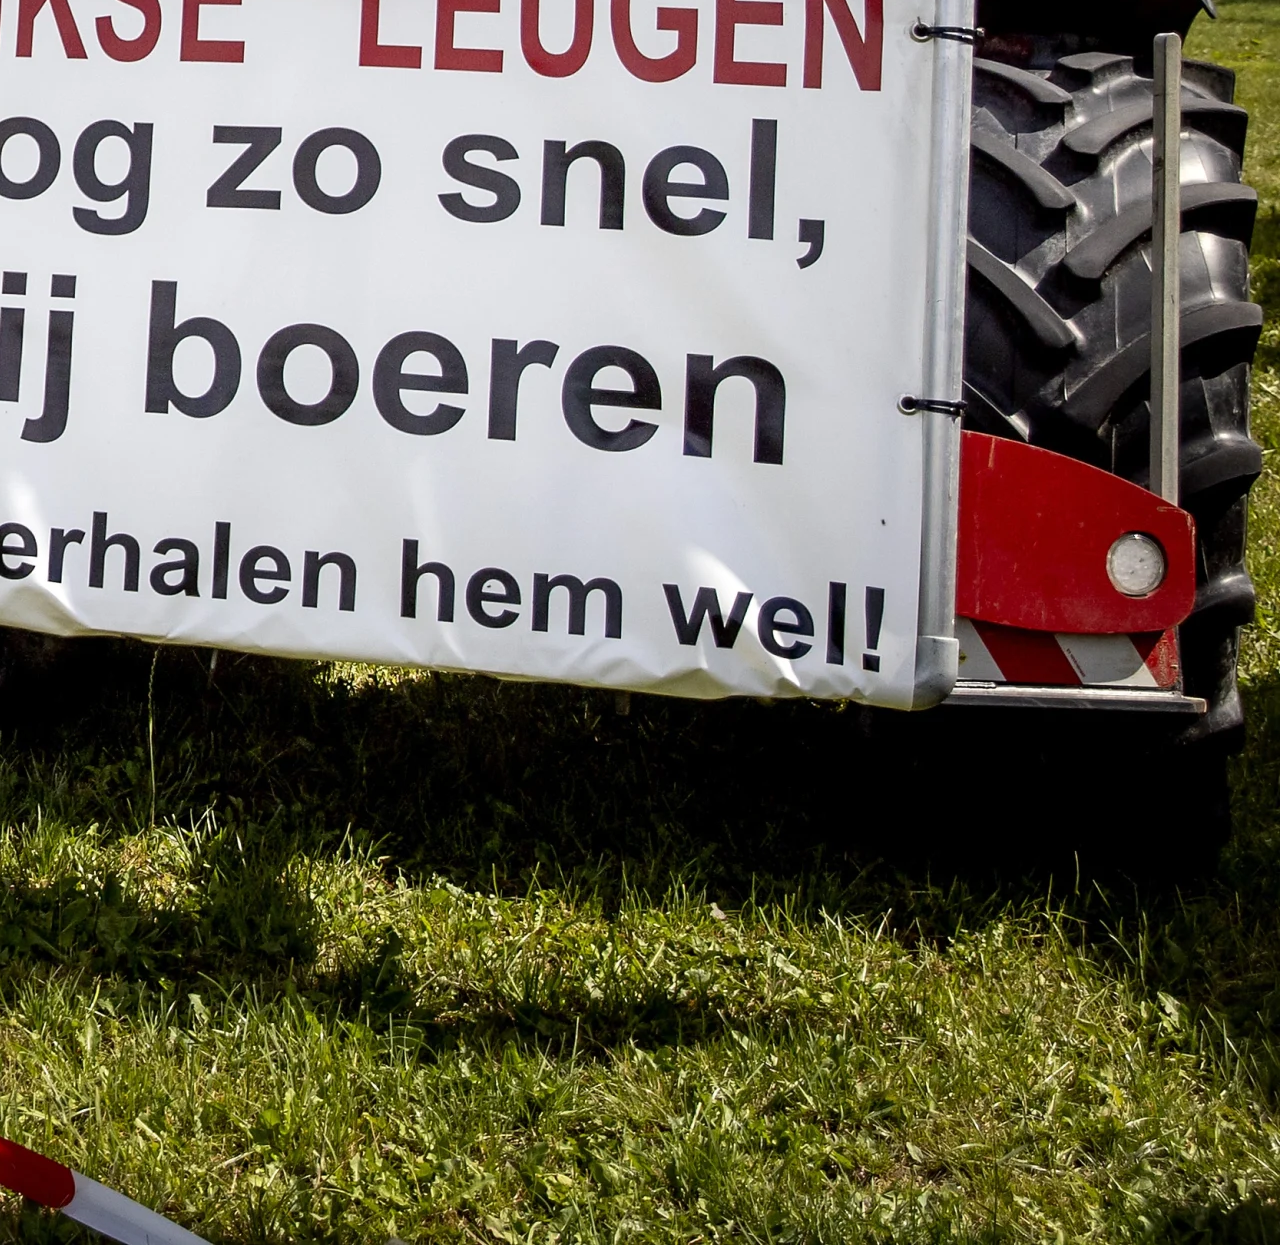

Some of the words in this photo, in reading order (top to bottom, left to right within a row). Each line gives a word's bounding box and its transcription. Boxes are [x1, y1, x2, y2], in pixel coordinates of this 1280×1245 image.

[206, 125, 382, 215] zo
[437, 118, 828, 270] snel,
[144, 280, 786, 466] boeren
[400, 538, 623, 640] hem
[662, 581, 886, 671] wel!
